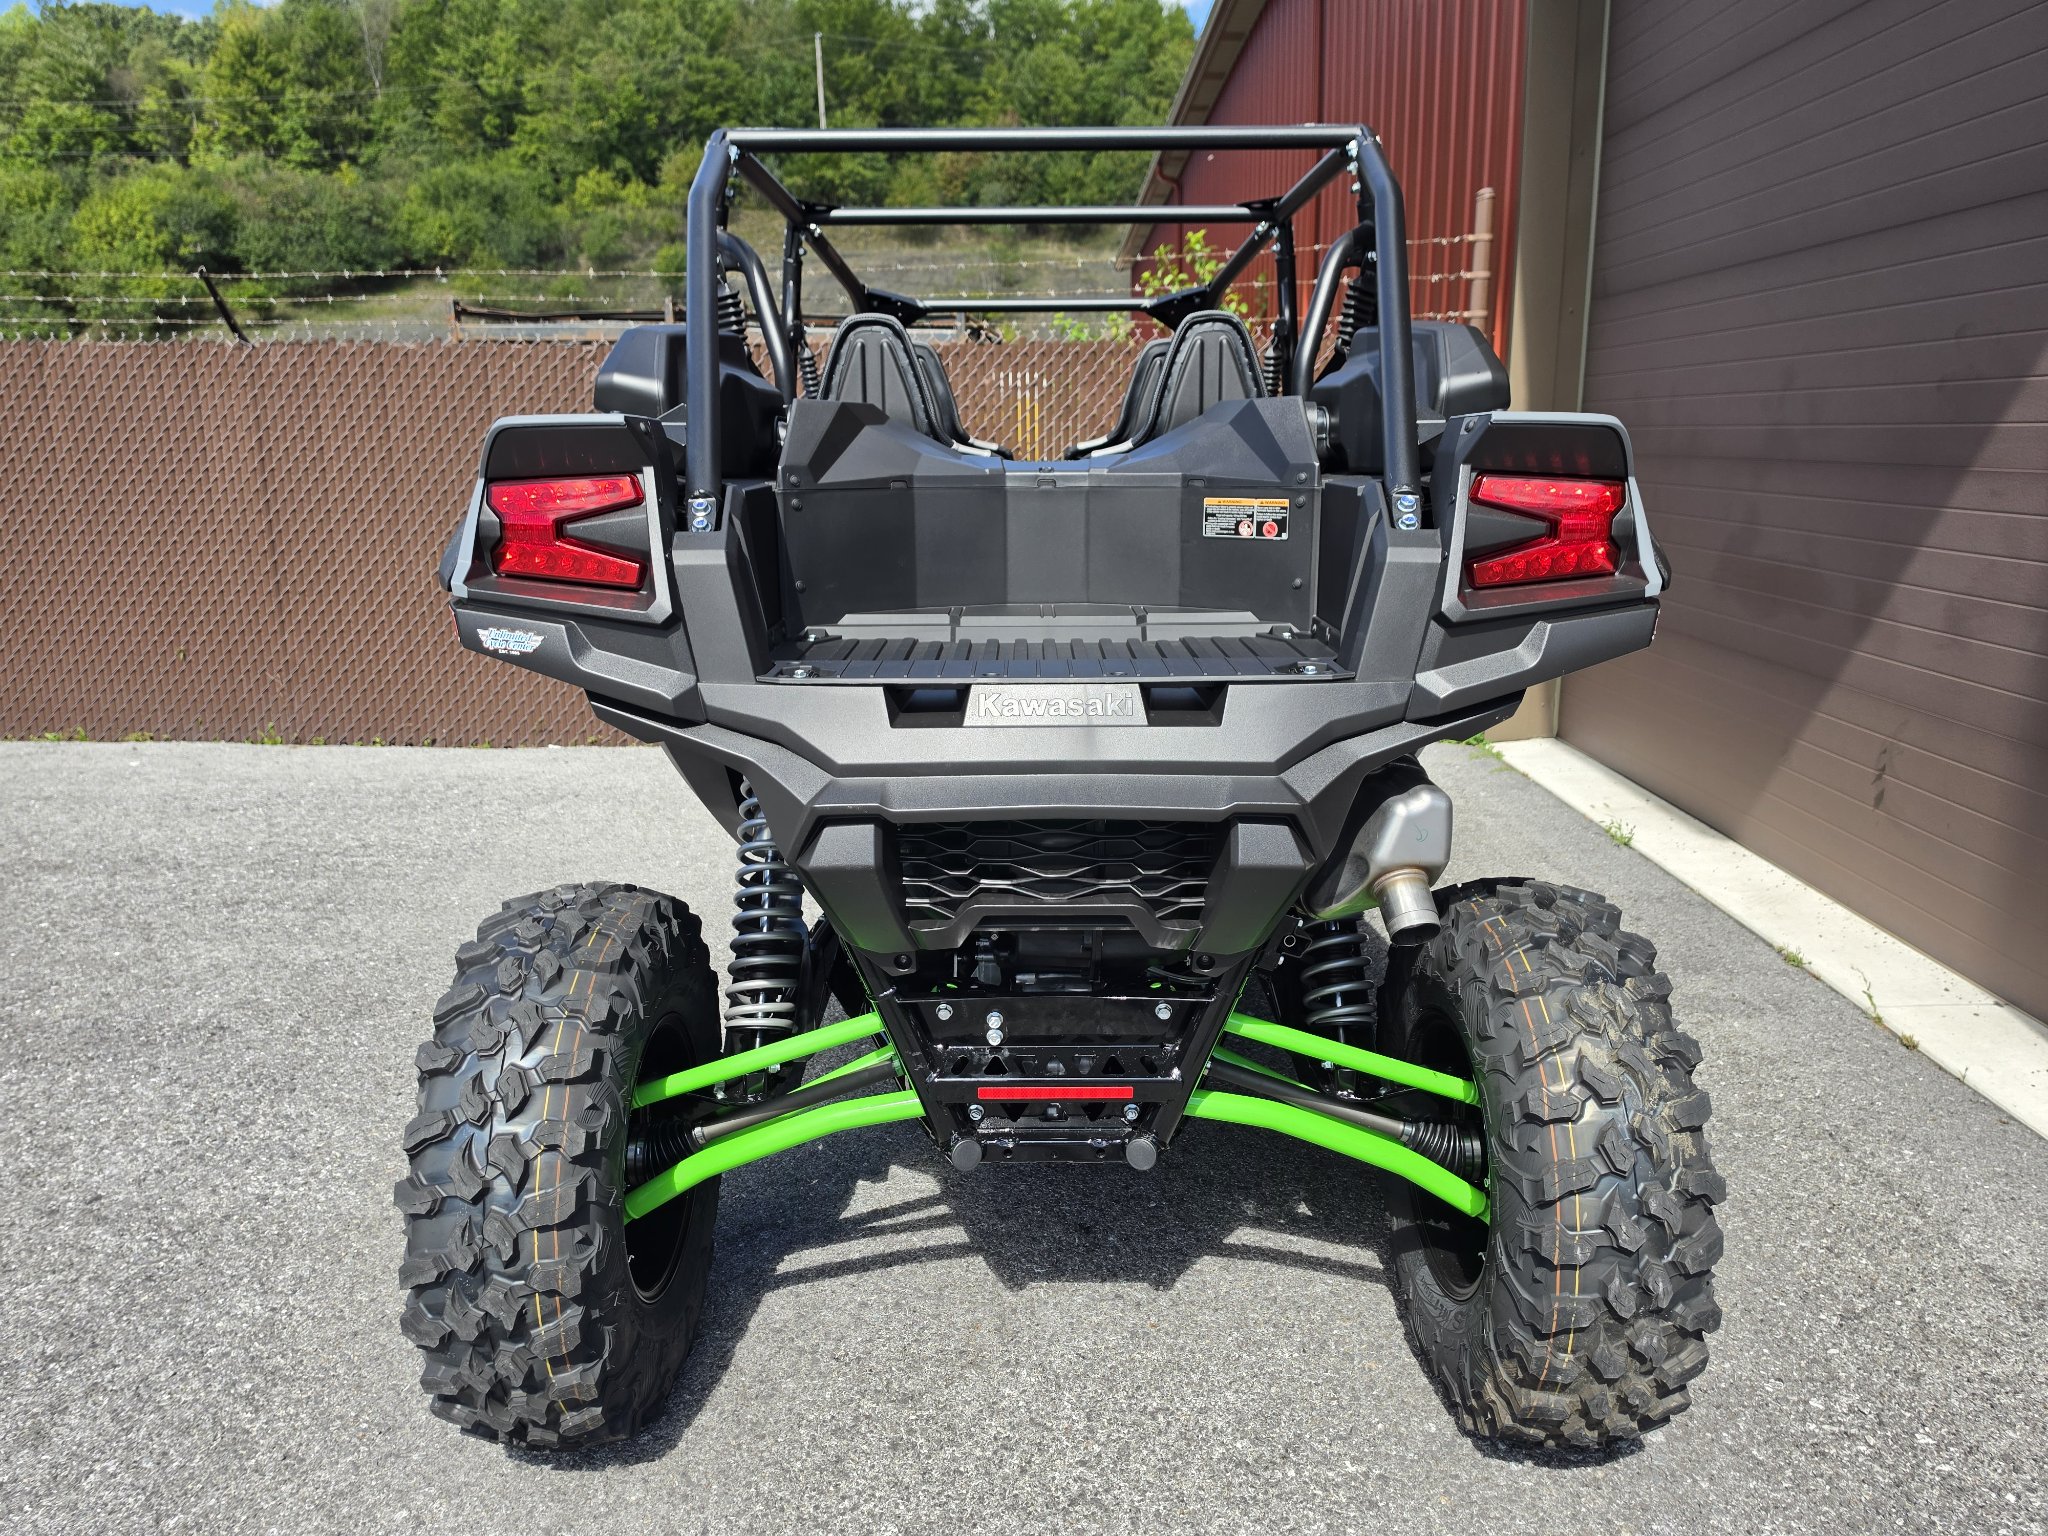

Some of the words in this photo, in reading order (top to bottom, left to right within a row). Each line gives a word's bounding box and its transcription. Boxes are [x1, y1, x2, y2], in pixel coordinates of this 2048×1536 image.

[489, 629, 533, 642] Unlimited
[484, 639, 505, 650] Cycle
[507, 640, 534, 651] Center
[978, 692, 1134, 717] Kawasaki
